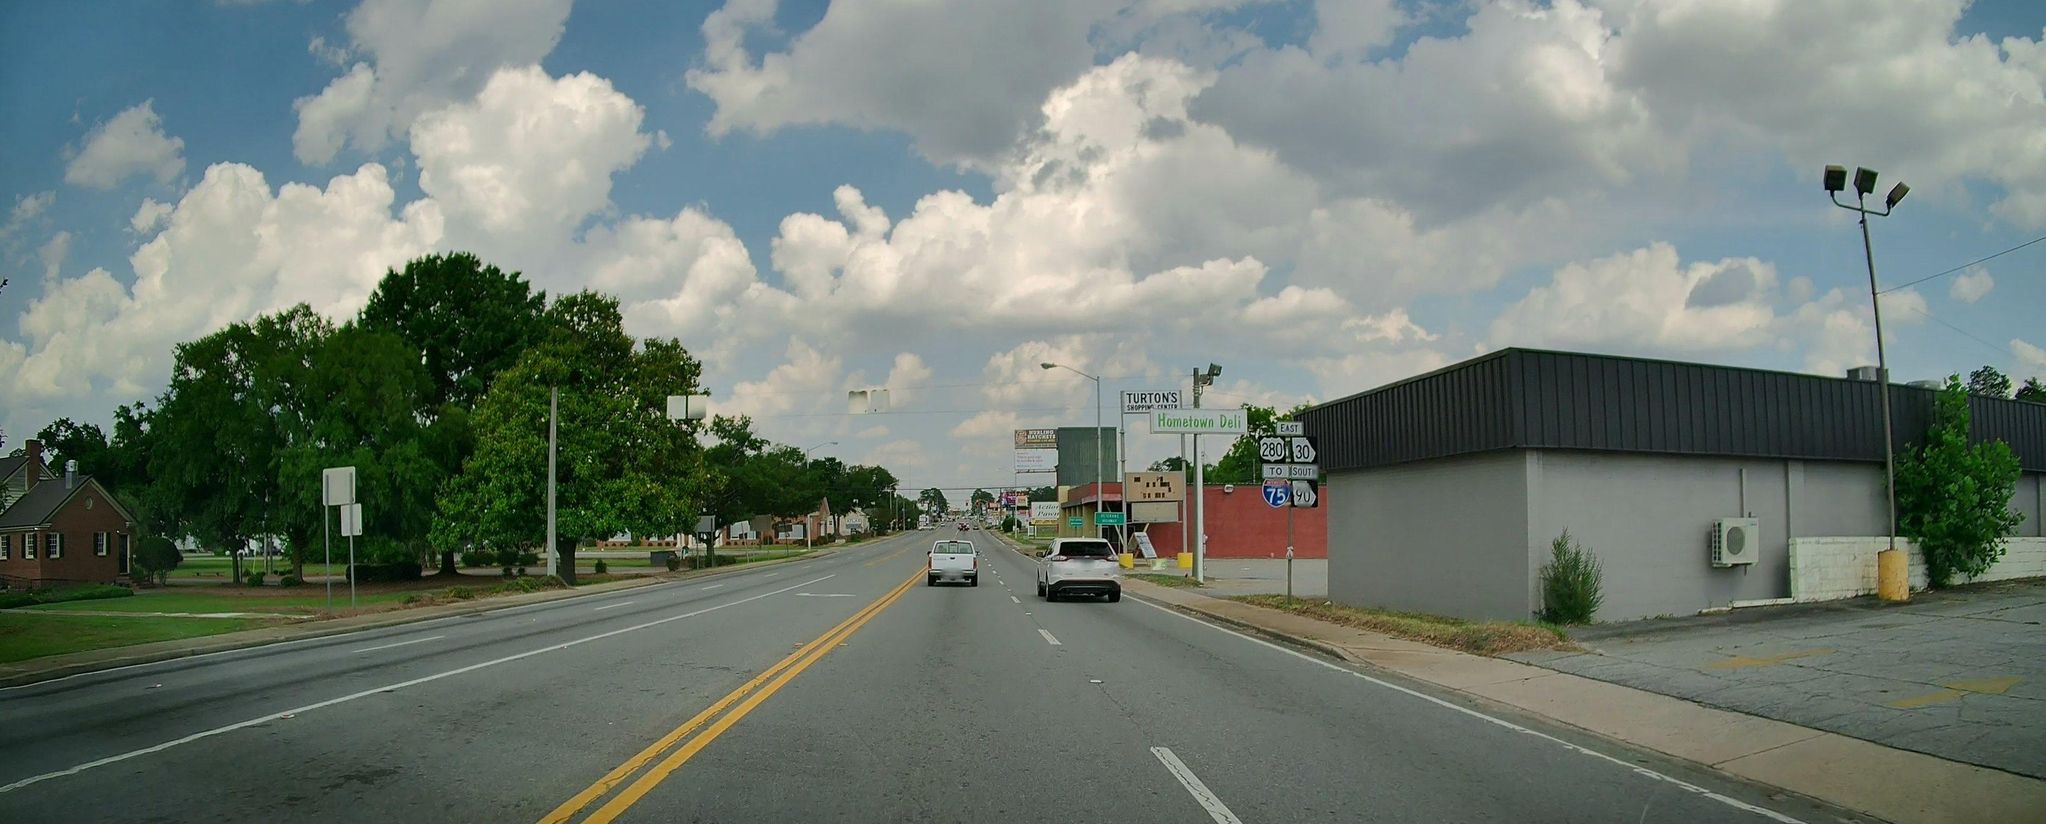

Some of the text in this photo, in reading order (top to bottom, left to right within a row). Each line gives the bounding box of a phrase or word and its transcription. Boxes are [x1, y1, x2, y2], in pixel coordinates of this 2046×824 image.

[1126, 391, 1178, 404] TURTON'S
[1157, 413, 1241, 428] Hometown Deli
[1280, 423, 1299, 433] EAST
[1261, 442, 1283, 457] 280
[1295, 444, 1310, 459] 30
[1269, 467, 1283, 476] TO
[1292, 467, 1316, 476] SOUT
[1266, 488, 1286, 504] 75
[1295, 489, 1311, 503] 90
